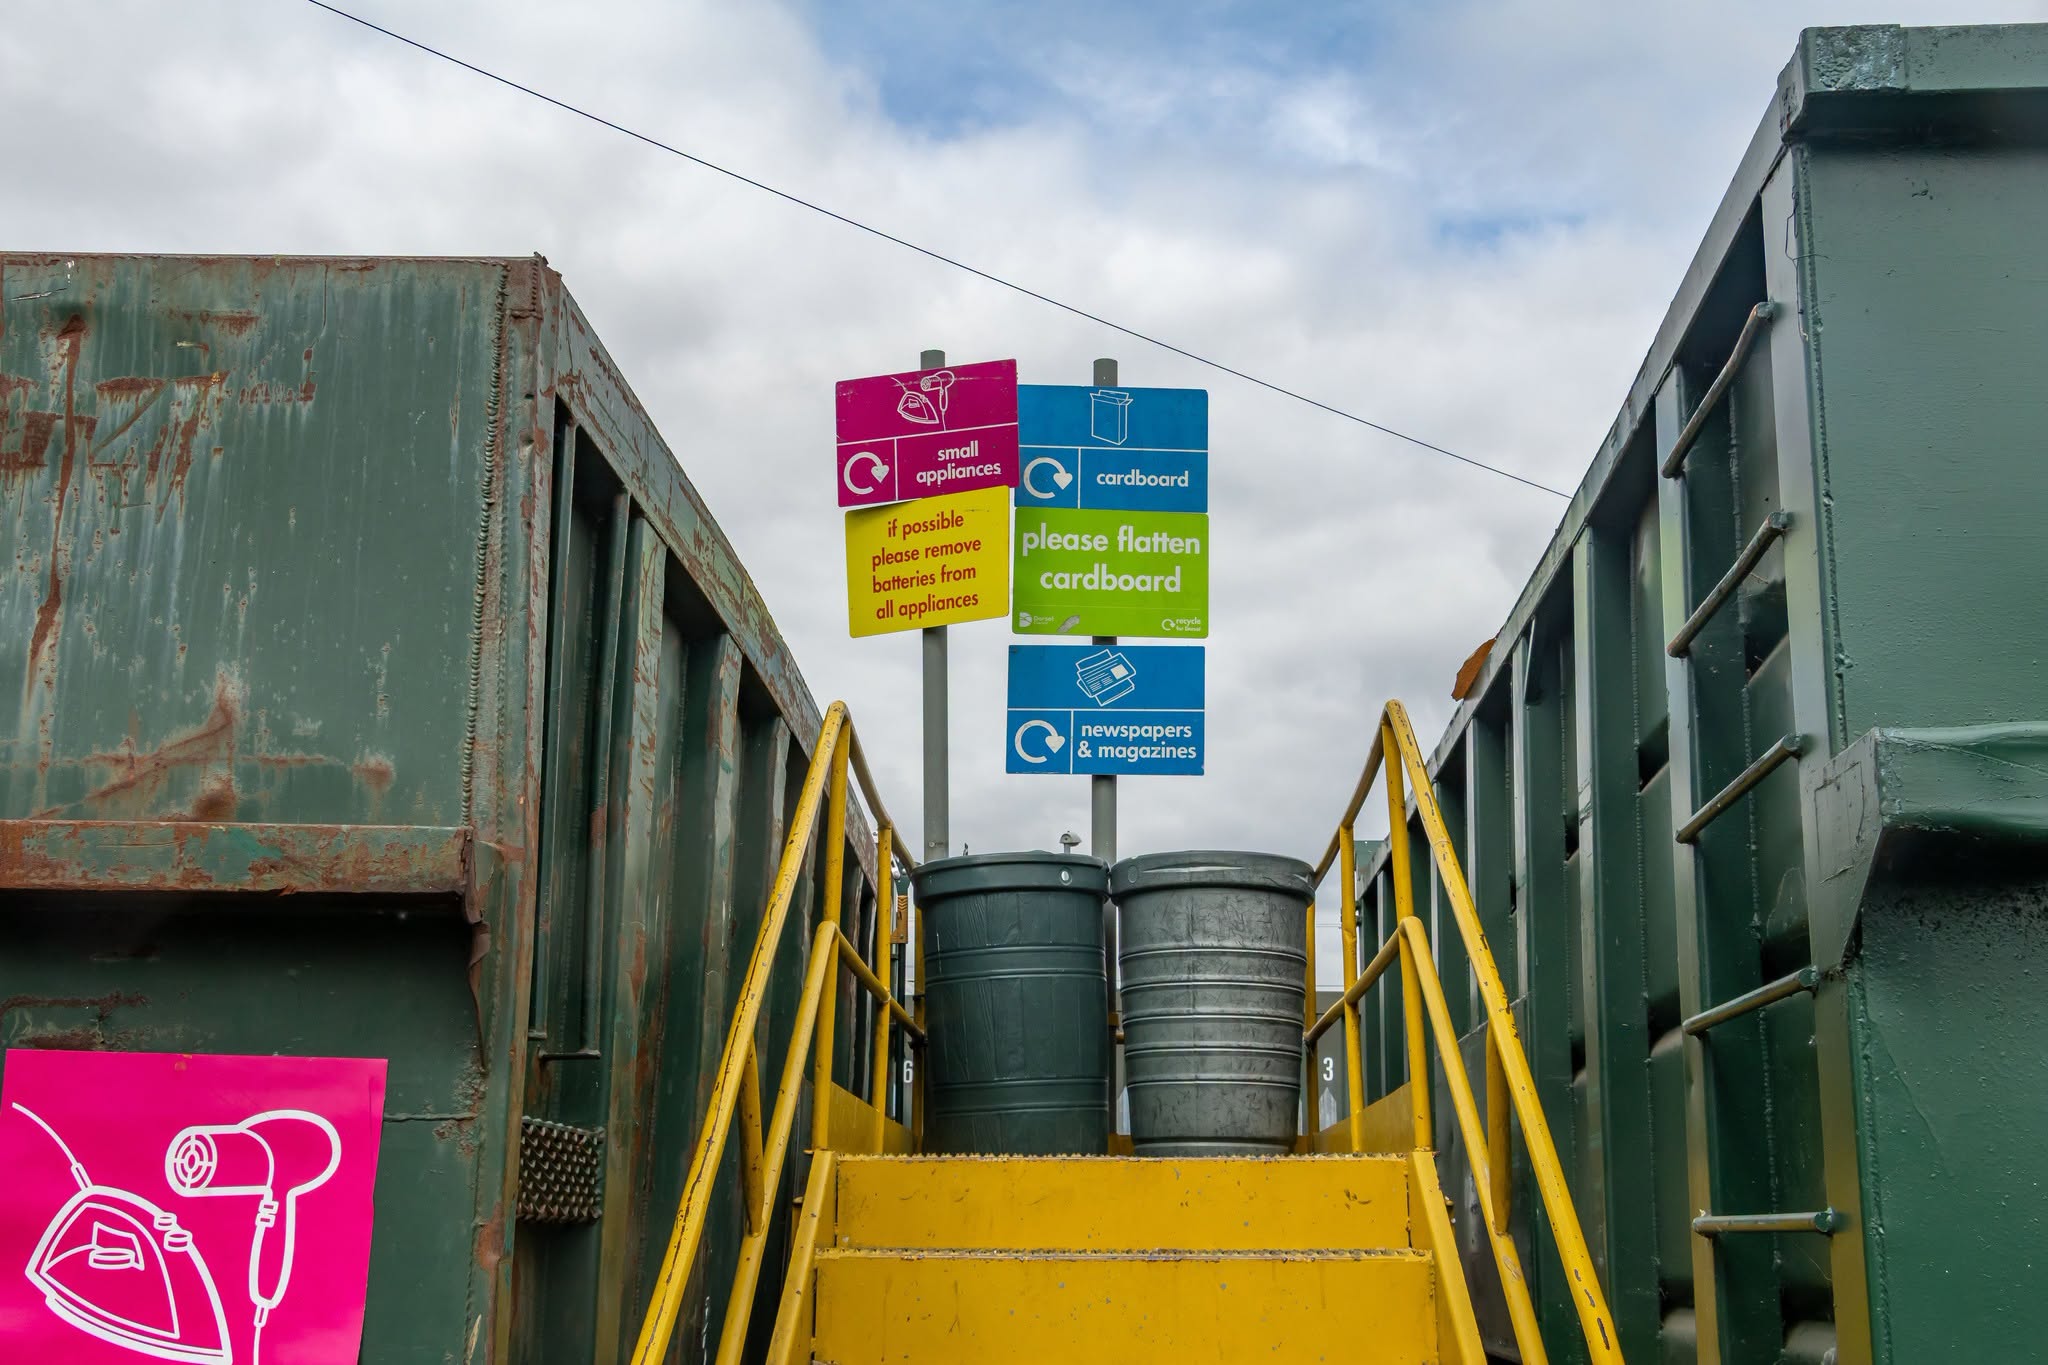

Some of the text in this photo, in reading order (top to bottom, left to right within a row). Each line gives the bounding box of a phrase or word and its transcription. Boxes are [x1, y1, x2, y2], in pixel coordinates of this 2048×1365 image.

[937, 440, 979, 461] small
[916, 462, 1001, 485] appliances
[1096, 469, 1189, 487] cardboard
[888, 510, 964, 540] if possible
[1022, 523, 1200, 556] please flatten
[872, 539, 981, 572] please remove
[873, 564, 977, 593] batteries from
[1040, 563, 1181, 592] cardboard
[876, 593, 979, 620] all appliances
[1176, 616, 1201, 627] recycle
[1081, 724, 1192, 741] newspapers
[1077, 740, 1196, 762] & magazines
[903, 1060, 913, 1083] 6
[1323, 1057, 1333, 1081] 3
